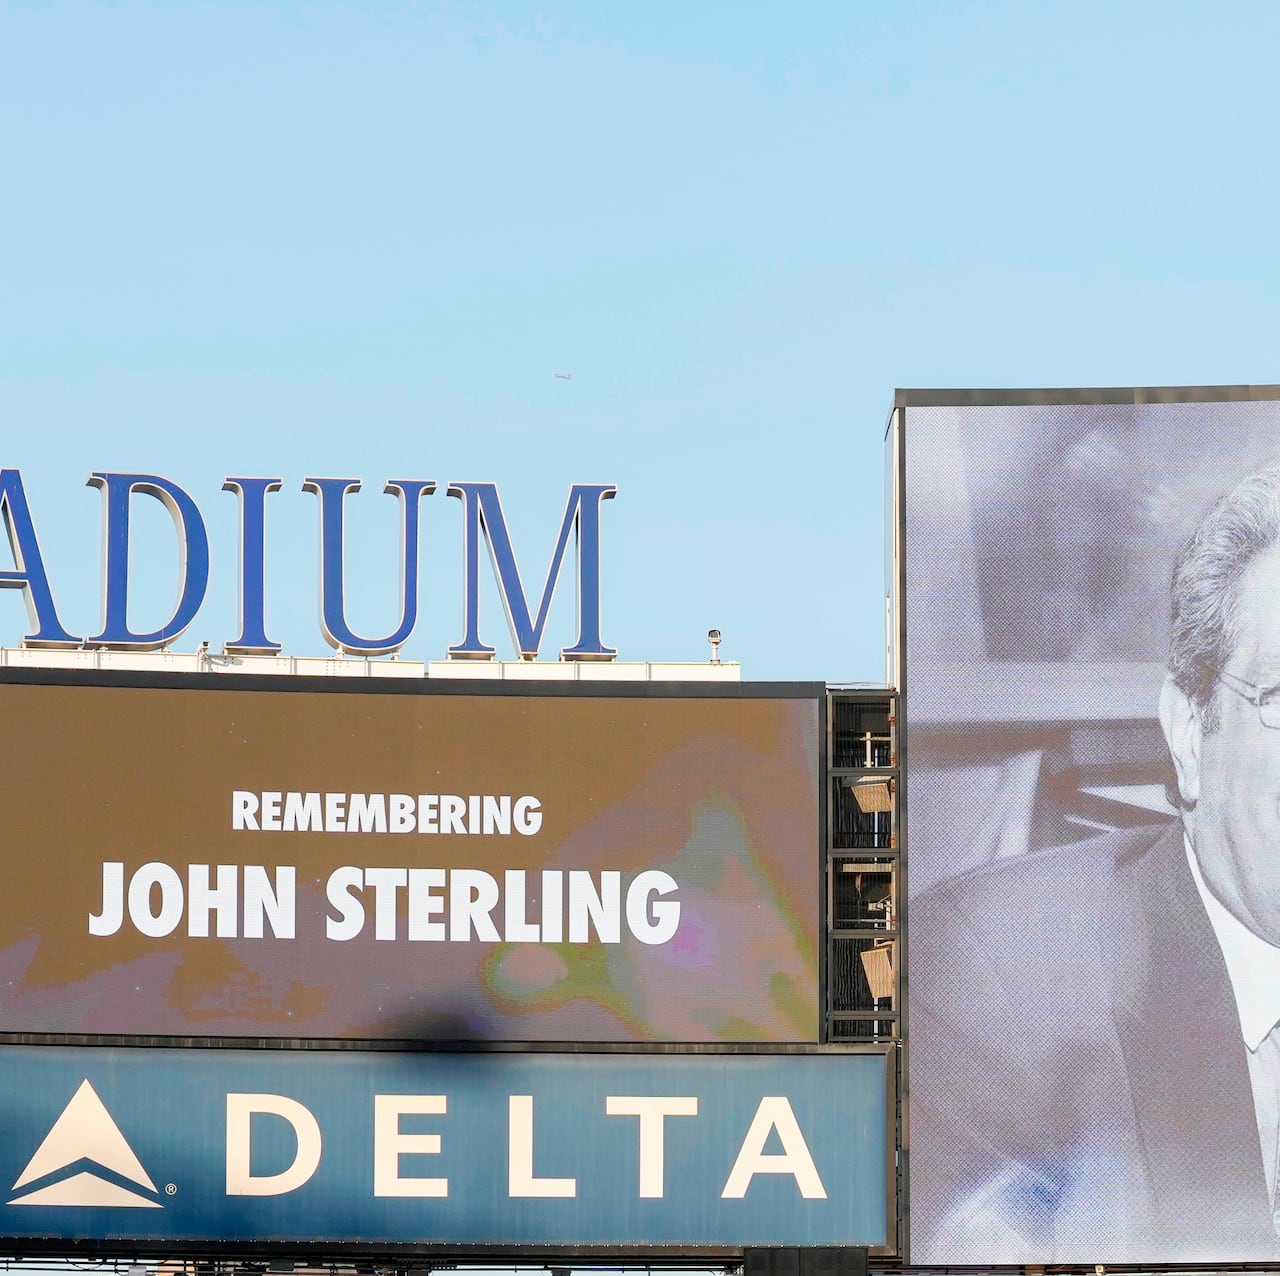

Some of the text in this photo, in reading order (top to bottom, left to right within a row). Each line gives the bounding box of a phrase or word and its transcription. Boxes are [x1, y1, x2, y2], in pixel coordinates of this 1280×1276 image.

[232, 791, 543, 836] REMEMBERING
[89, 862, 682, 946] JOHN STERLING
[225, 1092, 828, 1200] DELTA
